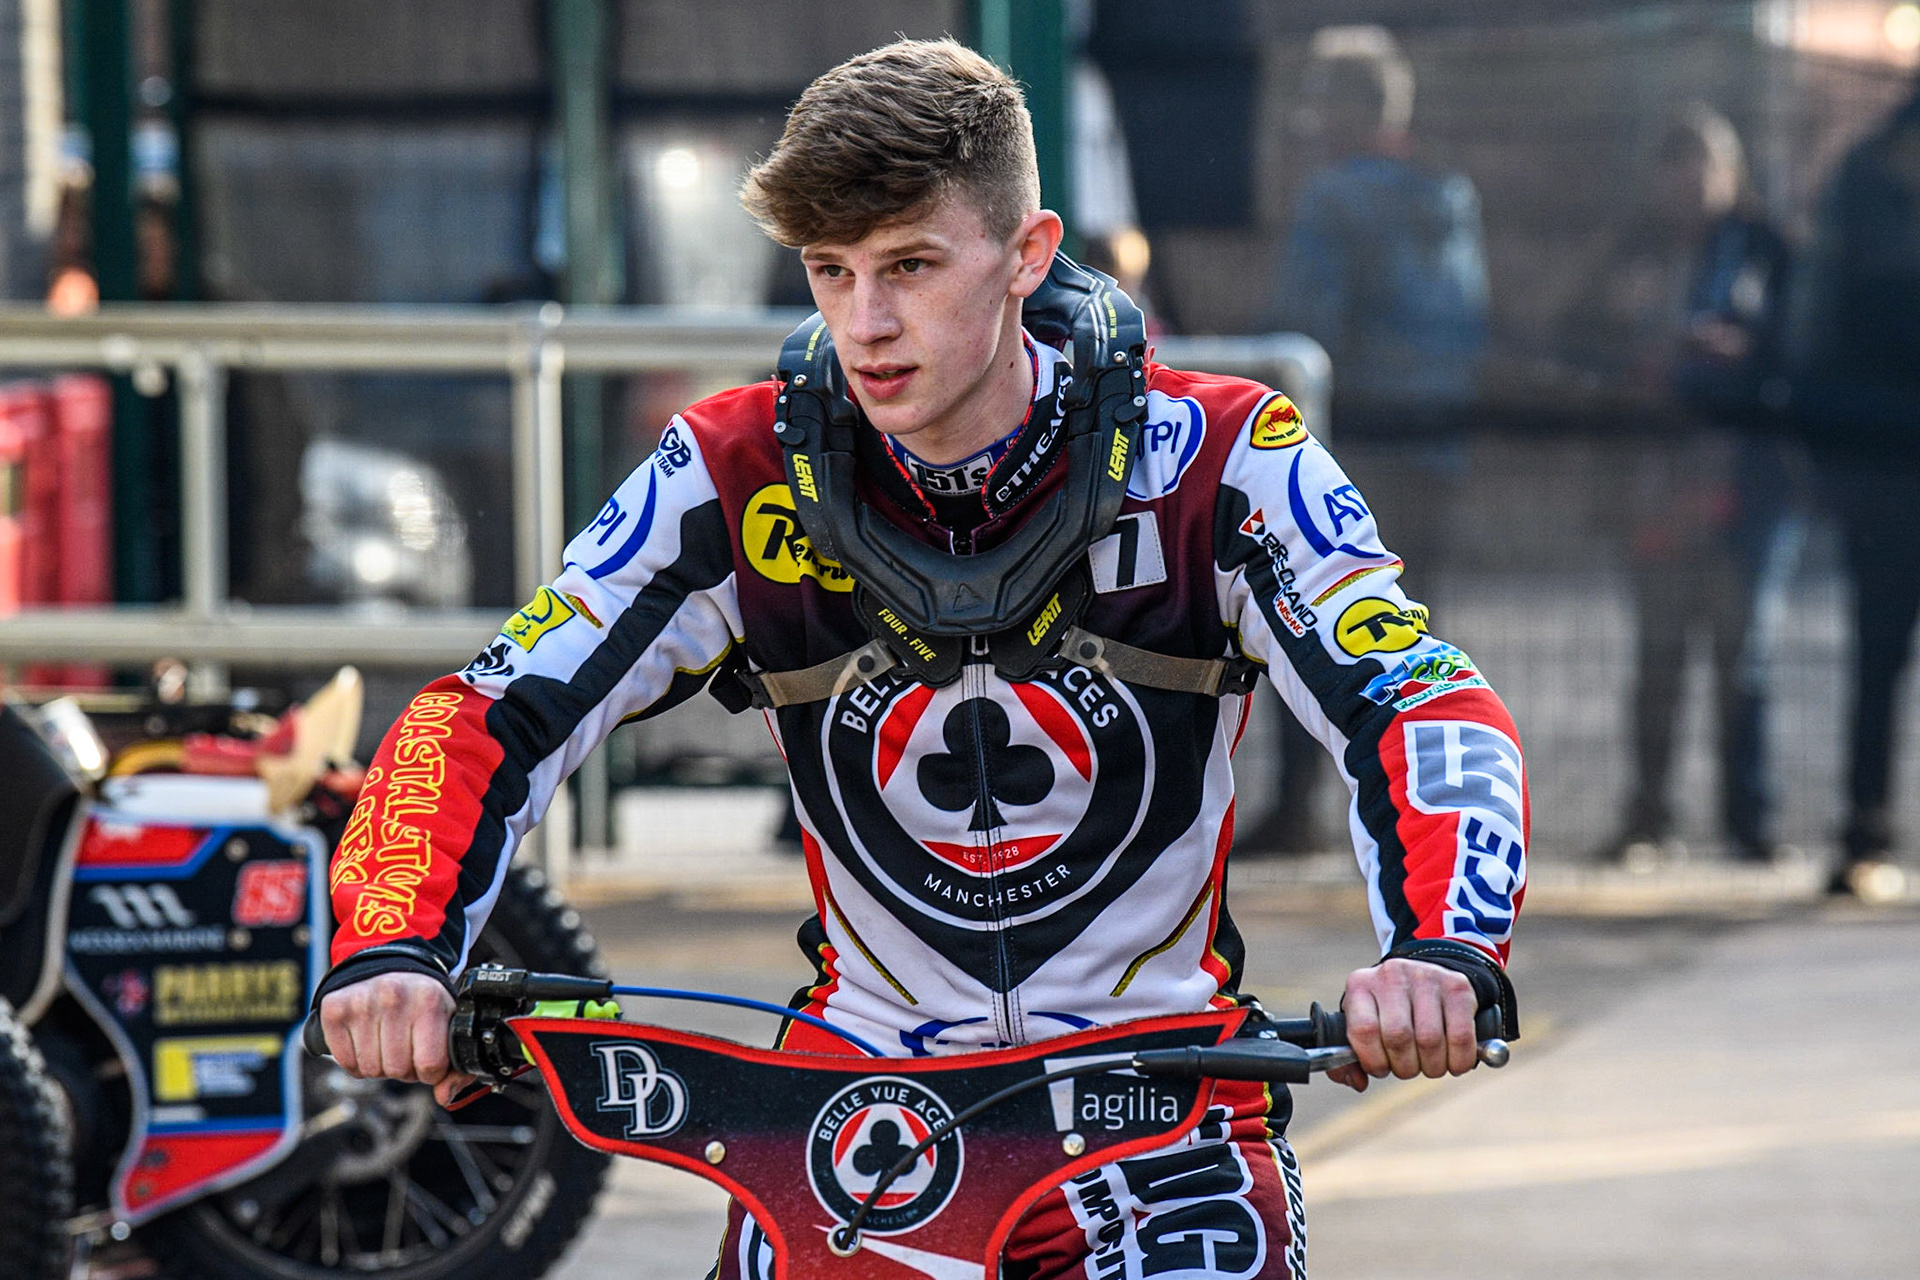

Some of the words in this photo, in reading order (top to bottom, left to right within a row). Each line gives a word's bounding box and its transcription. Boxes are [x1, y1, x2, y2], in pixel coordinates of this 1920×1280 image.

[877, 608, 908, 635] FOUR
[909, 637, 937, 662] FIVE
[382, 691, 464, 821] COASTAL
[353, 821, 432, 937] STOVES
[923, 863, 1072, 908] MANCHESTER
[818, 1091, 865, 1142] BELLE
[870, 1085, 910, 1104] VUE
[1081, 1086, 1180, 1131] agilia
